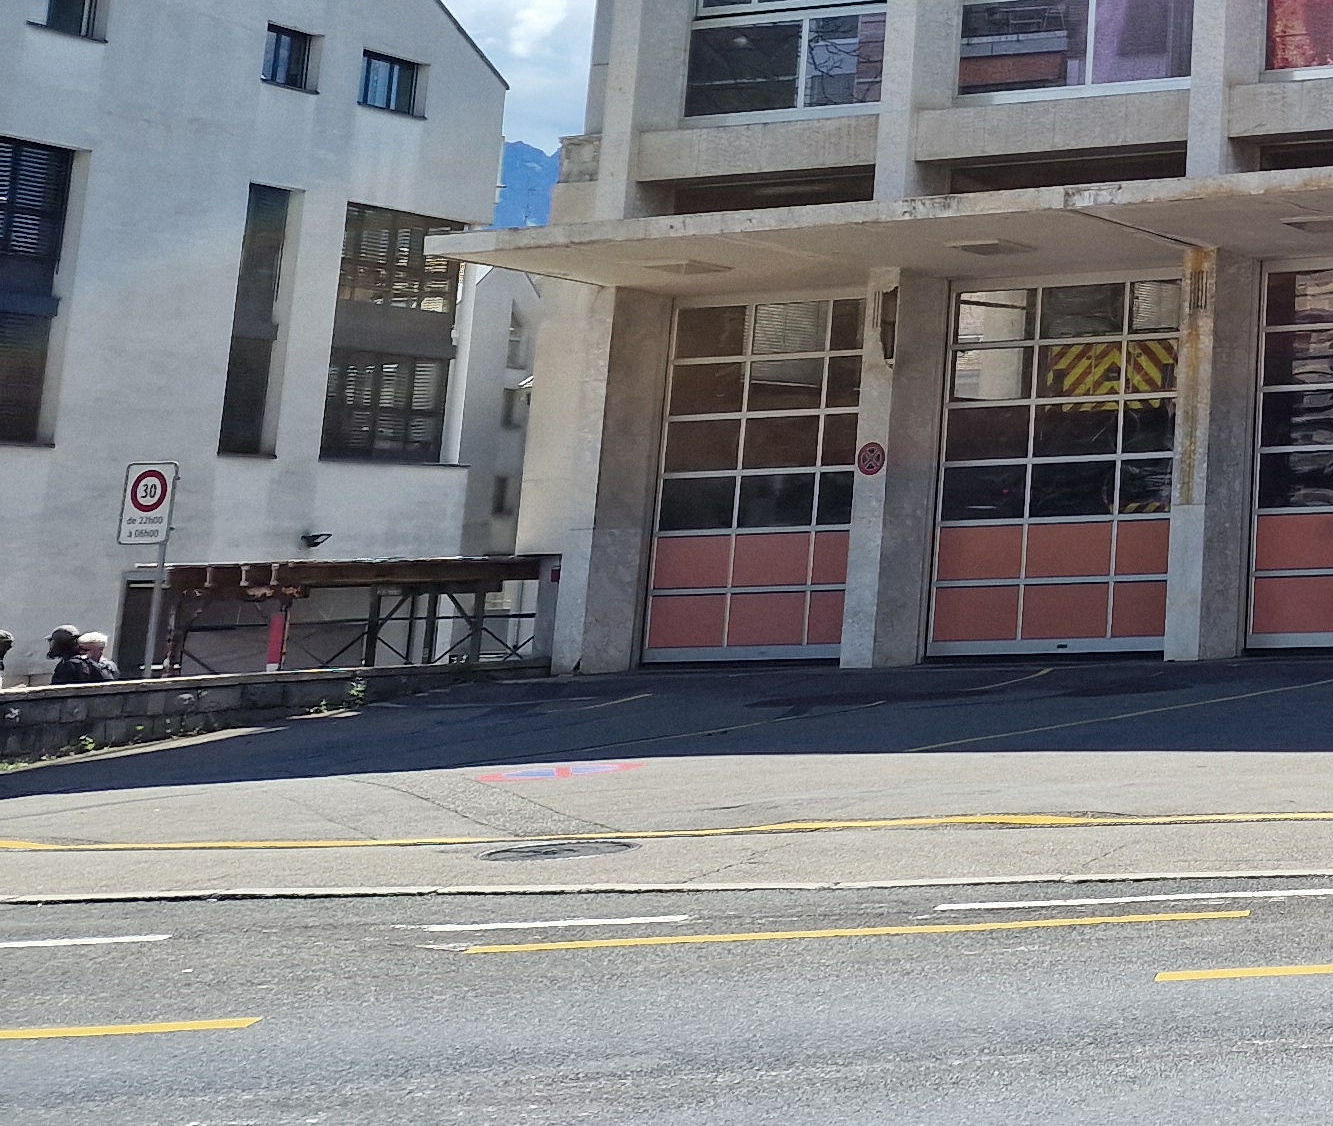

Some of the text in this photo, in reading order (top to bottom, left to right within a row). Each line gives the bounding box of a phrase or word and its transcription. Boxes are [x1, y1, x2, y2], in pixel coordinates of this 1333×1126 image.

[140, 483, 157, 499] 30
[126, 516, 163, 525] de 22h00
